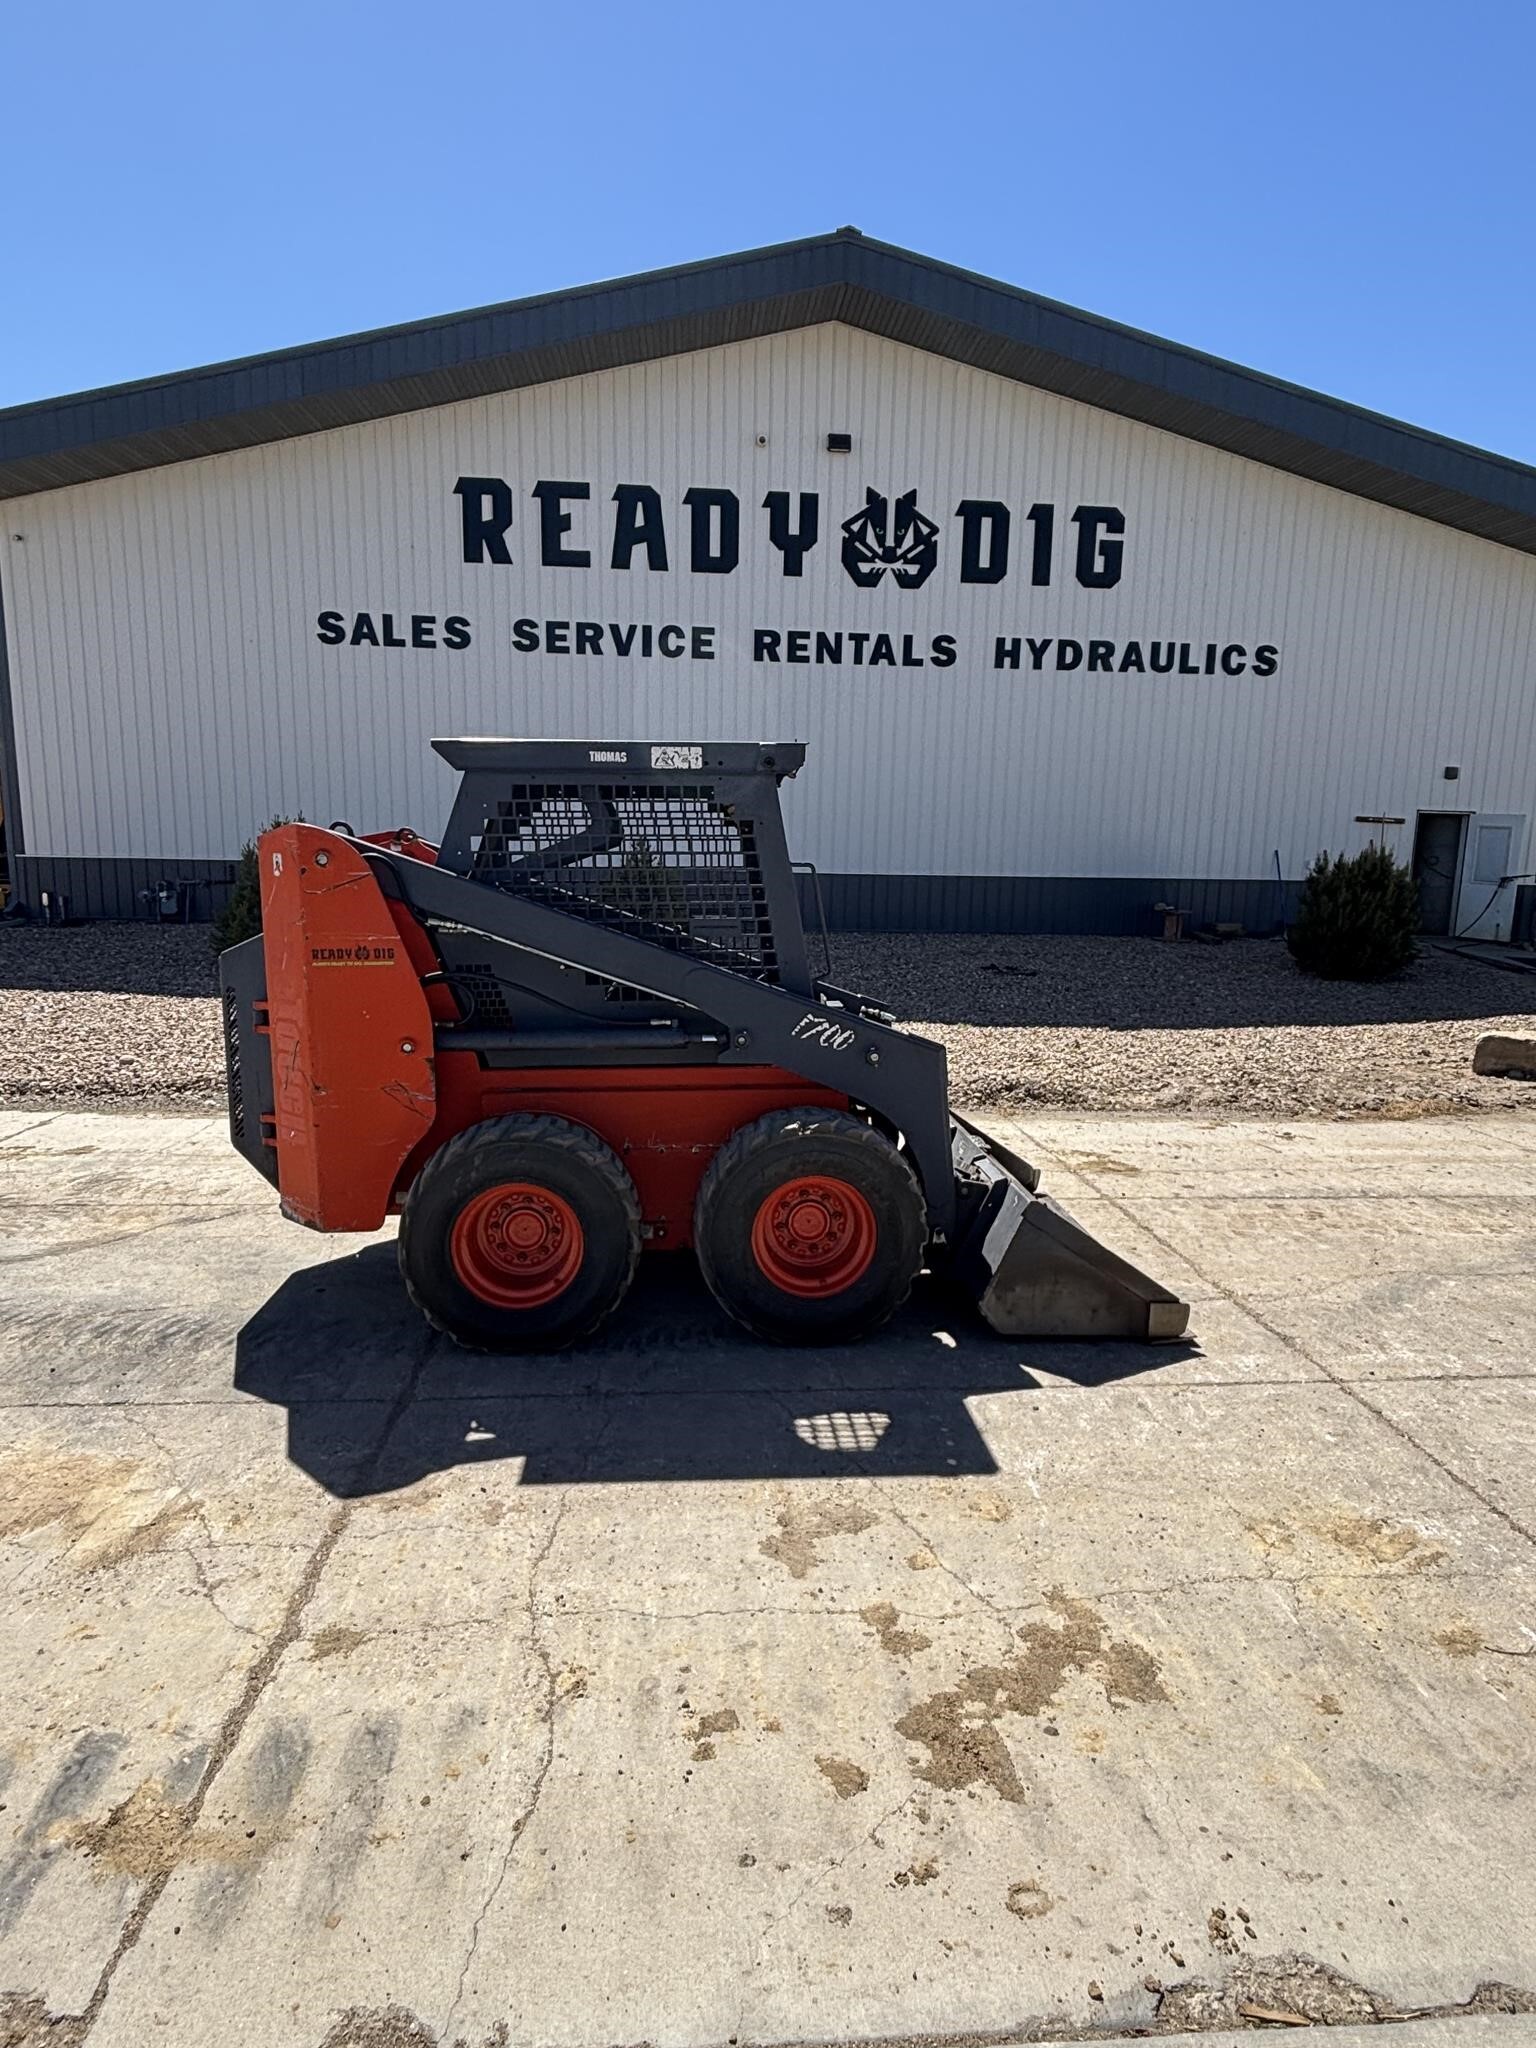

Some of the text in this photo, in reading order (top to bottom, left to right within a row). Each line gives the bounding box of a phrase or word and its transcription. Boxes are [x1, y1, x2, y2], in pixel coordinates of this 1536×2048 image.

[453, 477, 1125, 589] READY DIG
[317, 611, 1278, 676] SALES SERVICE RENTALS HYDRAULICS
[589, 751, 627, 763] THOMAS
[312, 947, 395, 960] READY DIG
[791, 1013, 855, 1050] 1700
